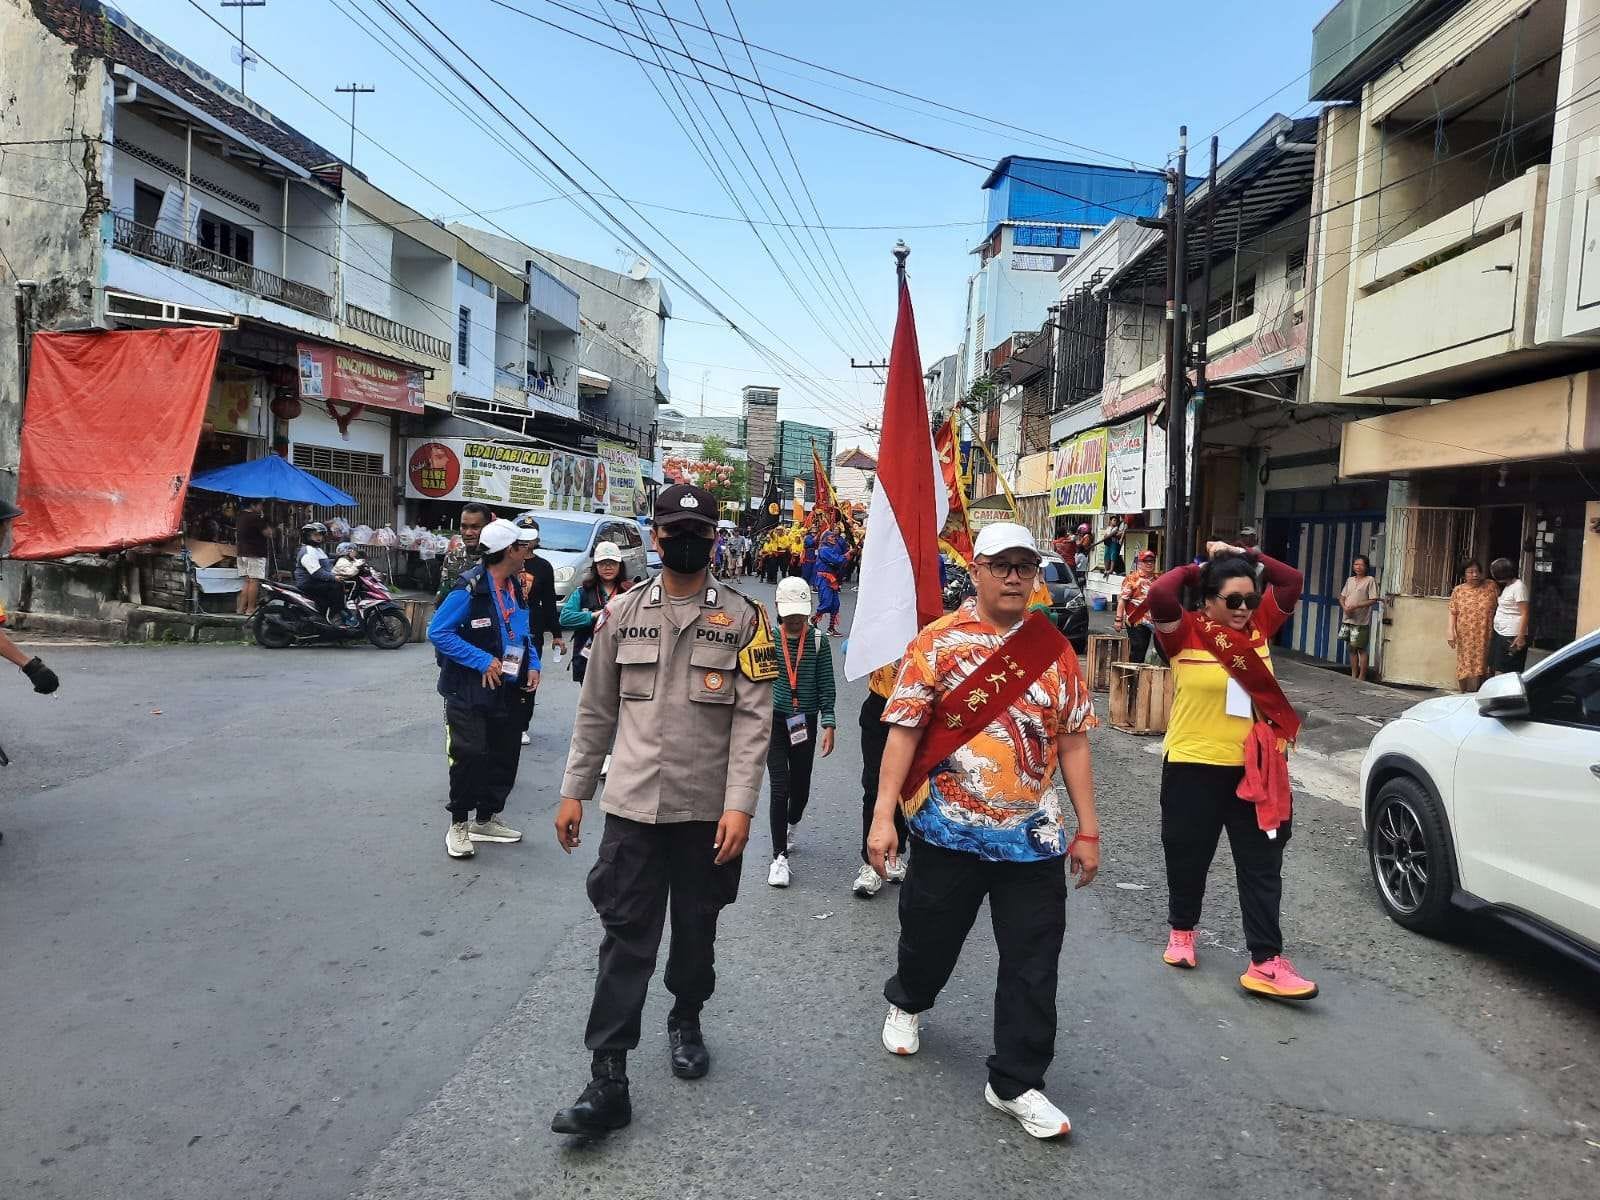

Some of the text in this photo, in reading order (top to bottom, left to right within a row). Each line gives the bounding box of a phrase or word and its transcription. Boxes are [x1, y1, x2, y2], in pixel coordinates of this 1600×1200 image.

[464, 443, 551, 467] KEDAI BABI RAJA
[421, 469, 447, 480] BABI
[421, 479, 447, 490] RAJA
[974, 510, 1010, 520] CAHAYA
[619, 626, 660, 640] YOKO
[696, 628, 739, 645] POLRI
